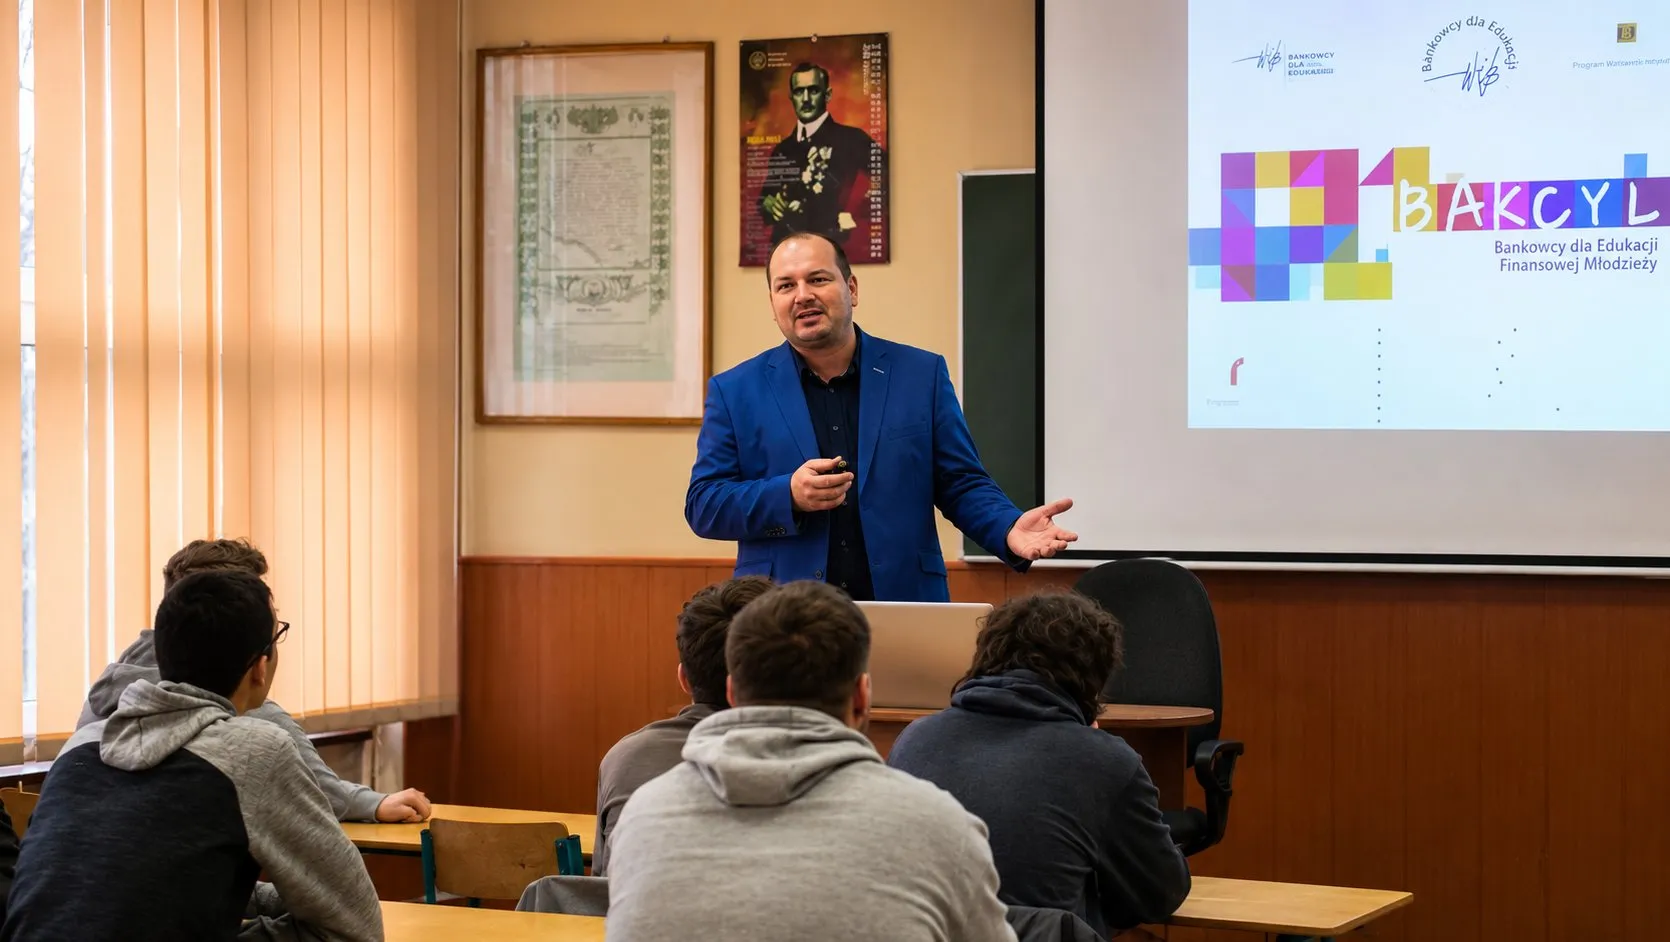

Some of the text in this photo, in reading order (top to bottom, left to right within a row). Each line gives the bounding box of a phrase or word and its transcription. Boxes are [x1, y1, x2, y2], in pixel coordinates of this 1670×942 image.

[1421, 20, 1462, 72] Bankowcy
[1288, 52, 1335, 61] BANKOWCY
[1572, 61, 1605, 70] Program
[1400, 178, 1661, 232] BAKCYL
[1494, 237, 1659, 257] Bankowcy dla Edukacji
[1499, 256, 1659, 275] Finansowej Młodzieży
